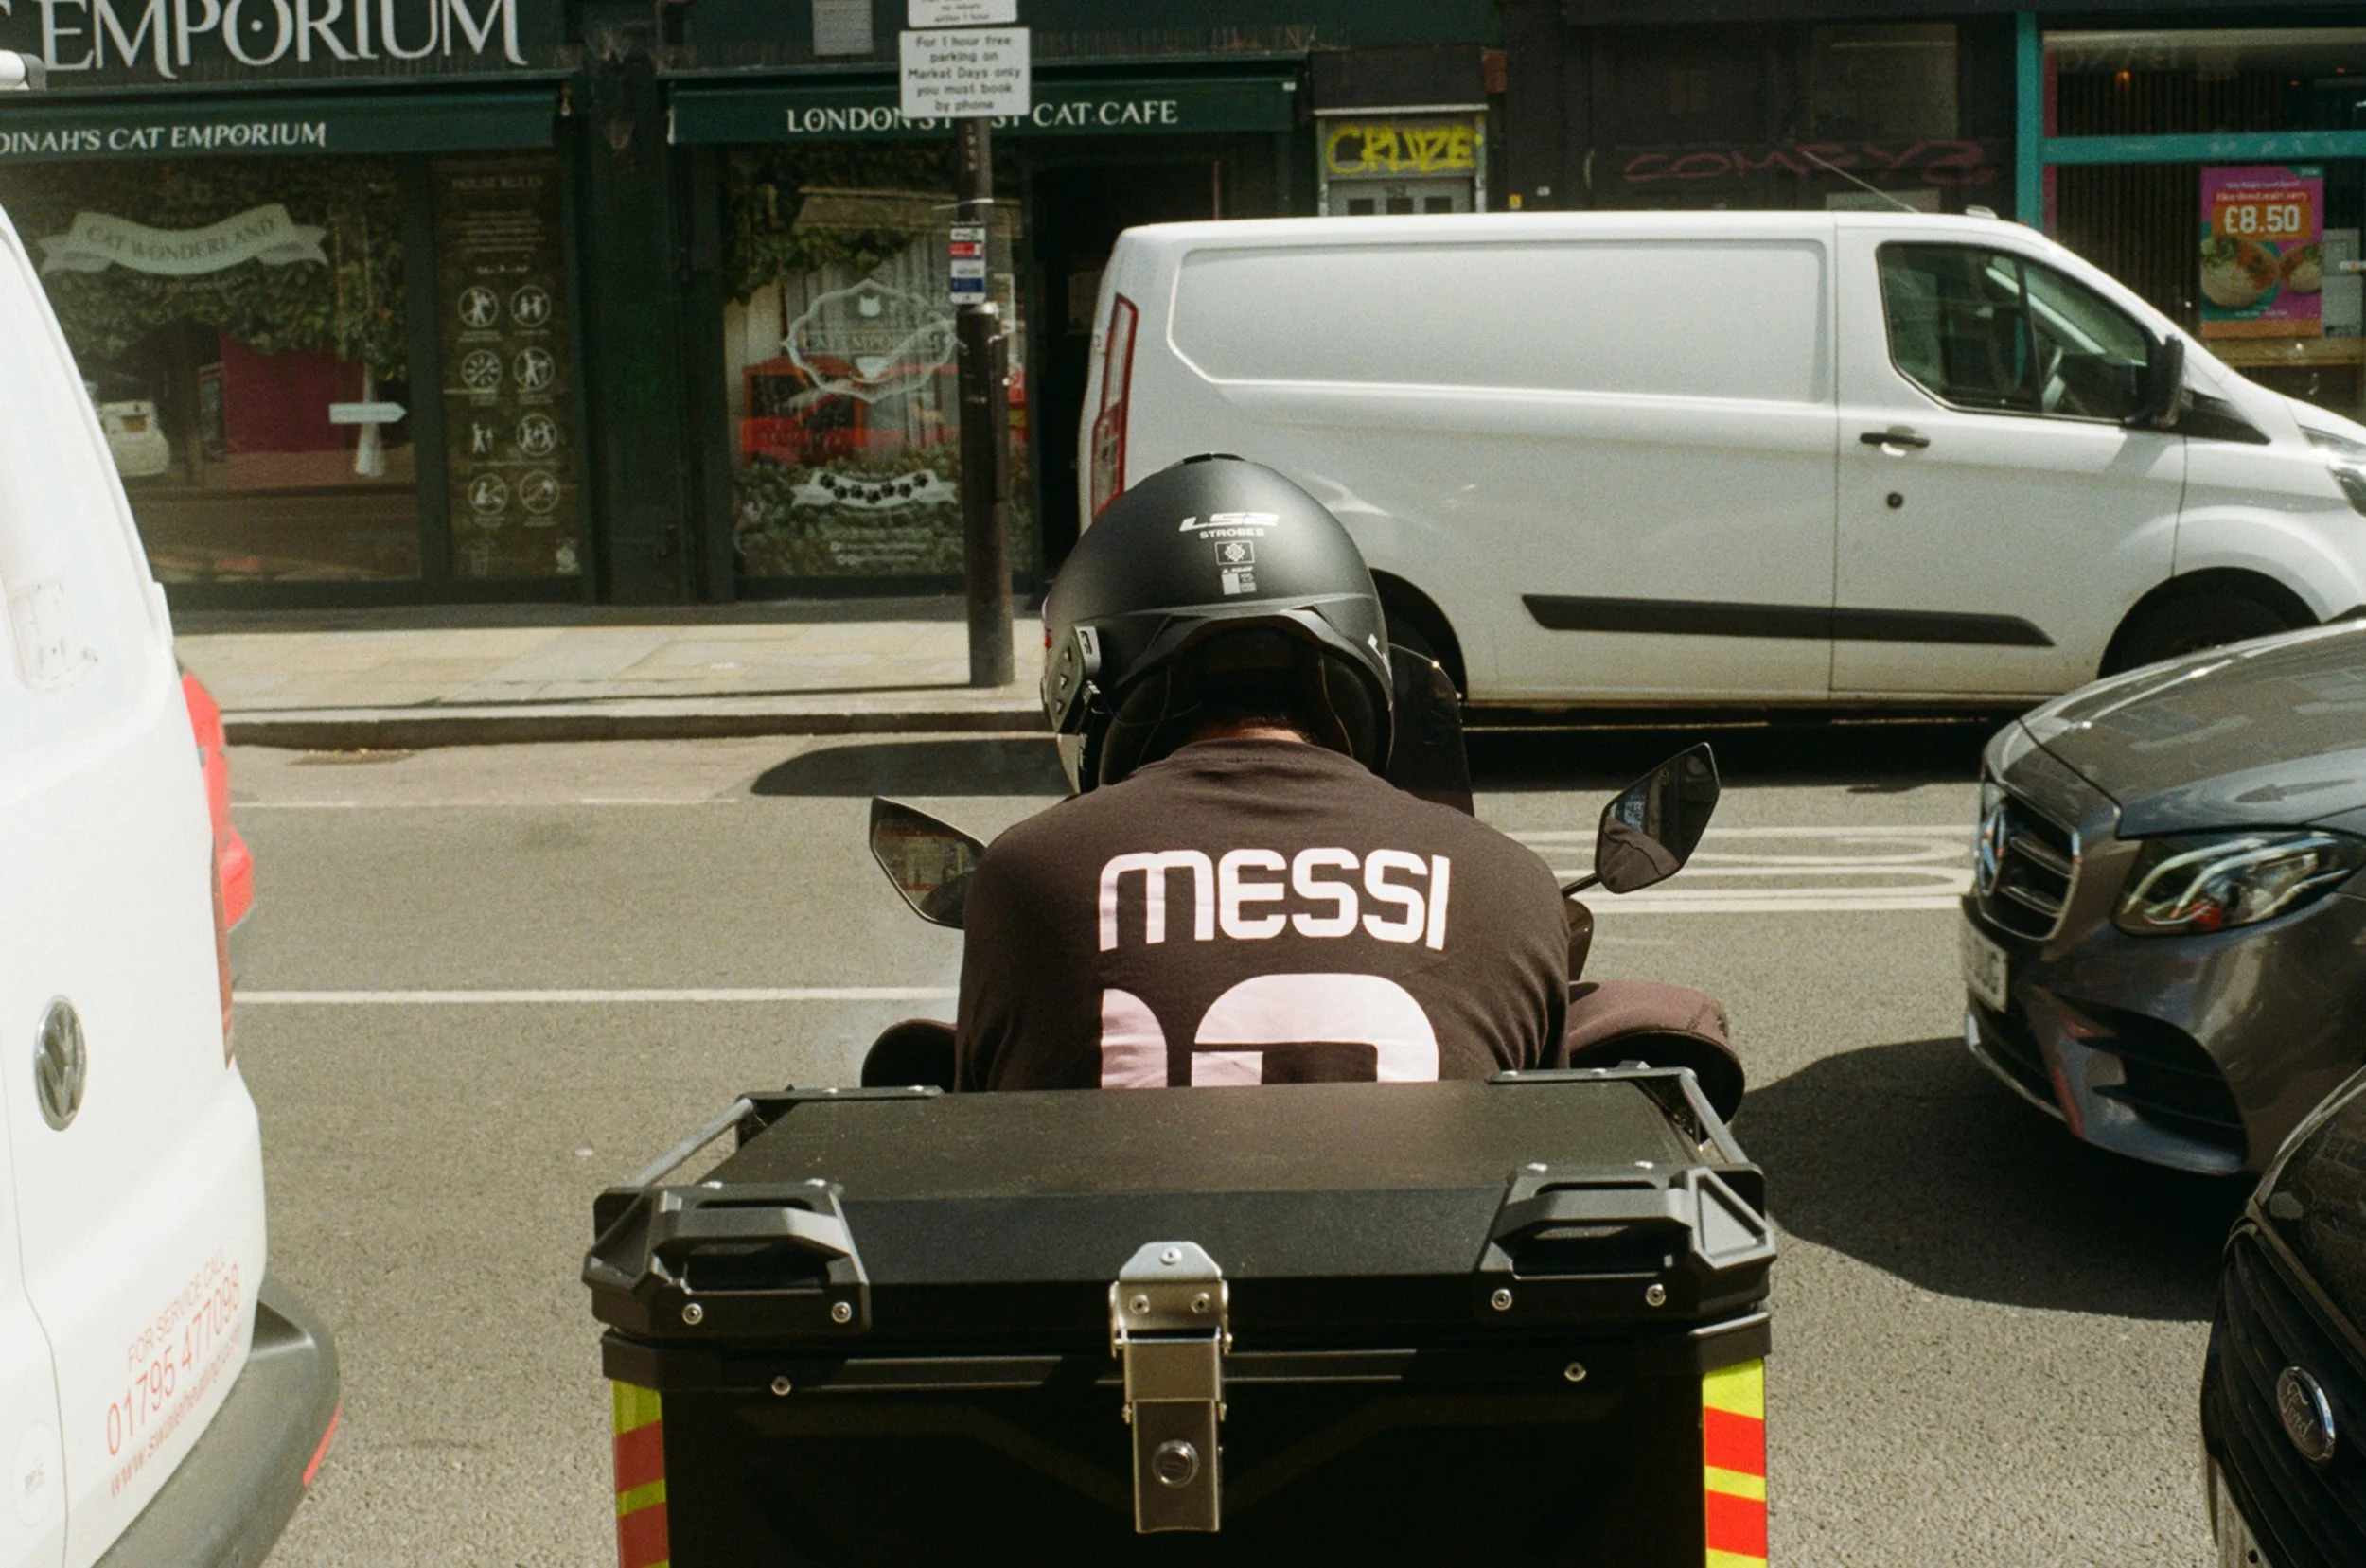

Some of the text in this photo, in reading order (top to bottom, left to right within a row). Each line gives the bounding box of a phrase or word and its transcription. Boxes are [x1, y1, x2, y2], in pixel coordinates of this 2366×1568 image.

[34, 0, 528, 79] EMPORIUM
[915, 34, 1012, 47] For 1 hour free
[908, 66, 1021, 79] Market Days only
[930, 51, 999, 64] parking on
[916, 82, 1013, 98] you must book
[788, 106, 937, 132] LONDONS
[1033, 101, 1092, 128] CAT
[1098, 99, 1179, 126] CAFE
[934, 98, 995, 113] by phone
[109, 126, 164, 151] CAT
[170, 121, 327, 150] EMPORIUM
[2223, 203, 2301, 234] £8.50
[85, 214, 276, 262] CAT WONDERLAND
[1179, 512, 1280, 532] LS2
[1098, 847, 1451, 953] MESSI
[107, 1262, 241, 1457] 01795 477098
